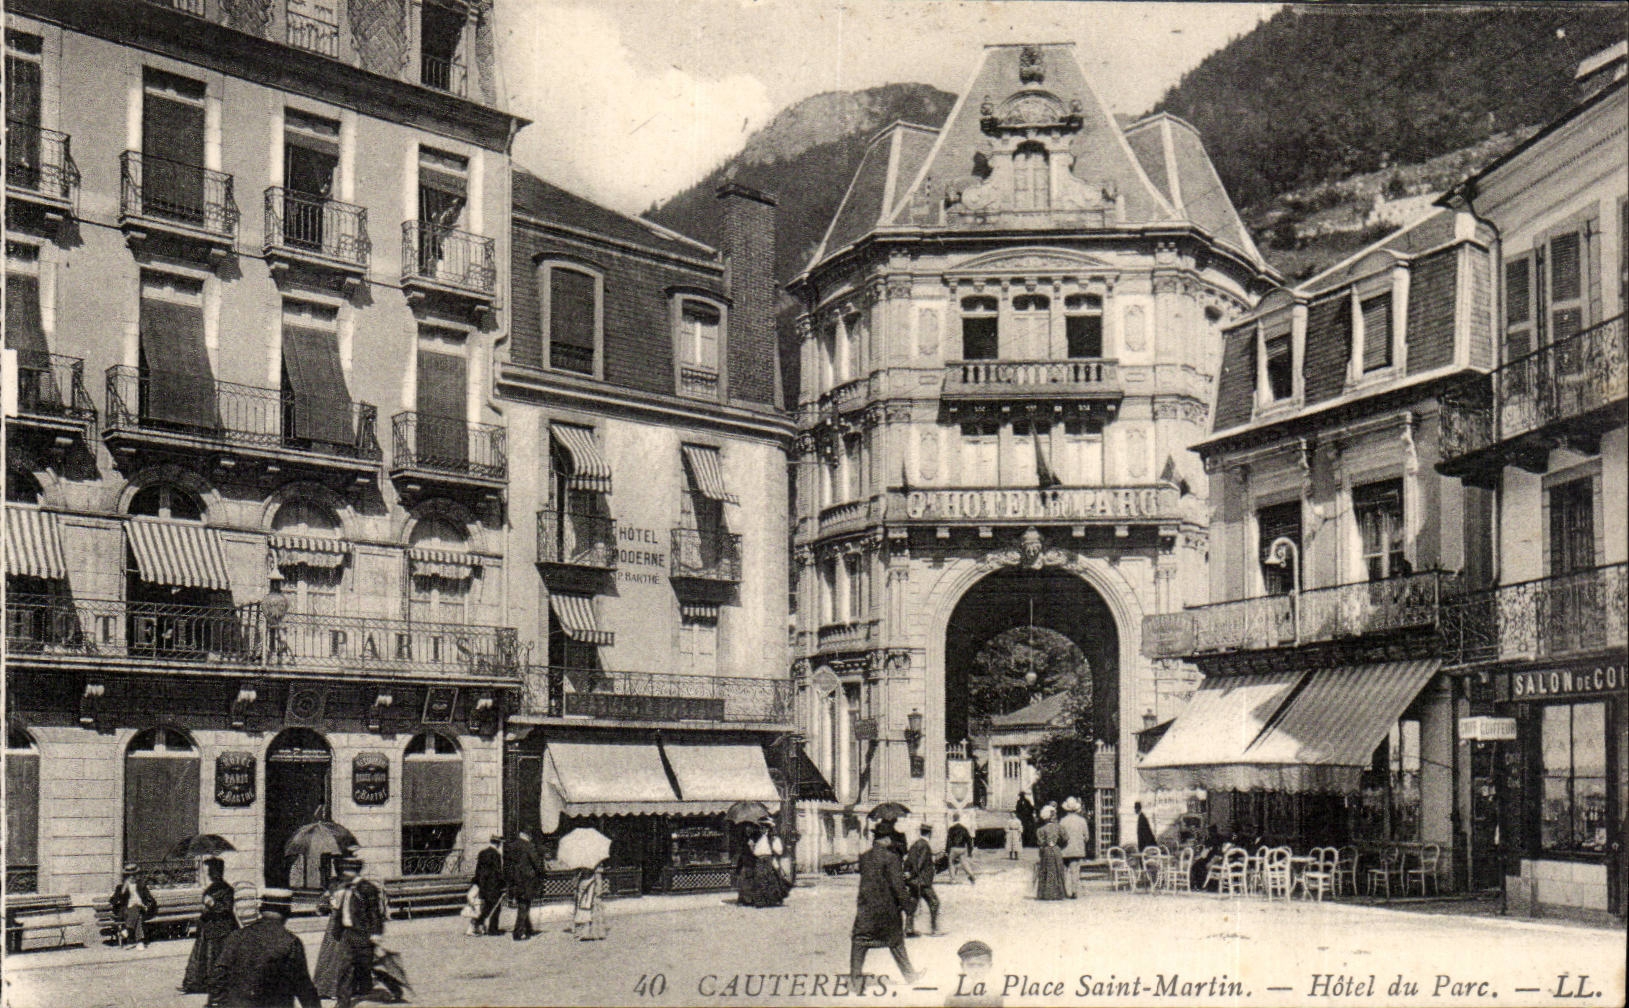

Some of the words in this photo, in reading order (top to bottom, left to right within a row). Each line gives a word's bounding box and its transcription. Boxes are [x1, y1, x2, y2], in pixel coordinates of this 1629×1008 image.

[1077, 490, 1159, 518] PARC
[328, 628, 474, 664] PARIS
[1515, 671, 1573, 696] SALON
[1577, 676, 1592, 691] DE
[1480, 721, 1517, 736] COIFFEUR
